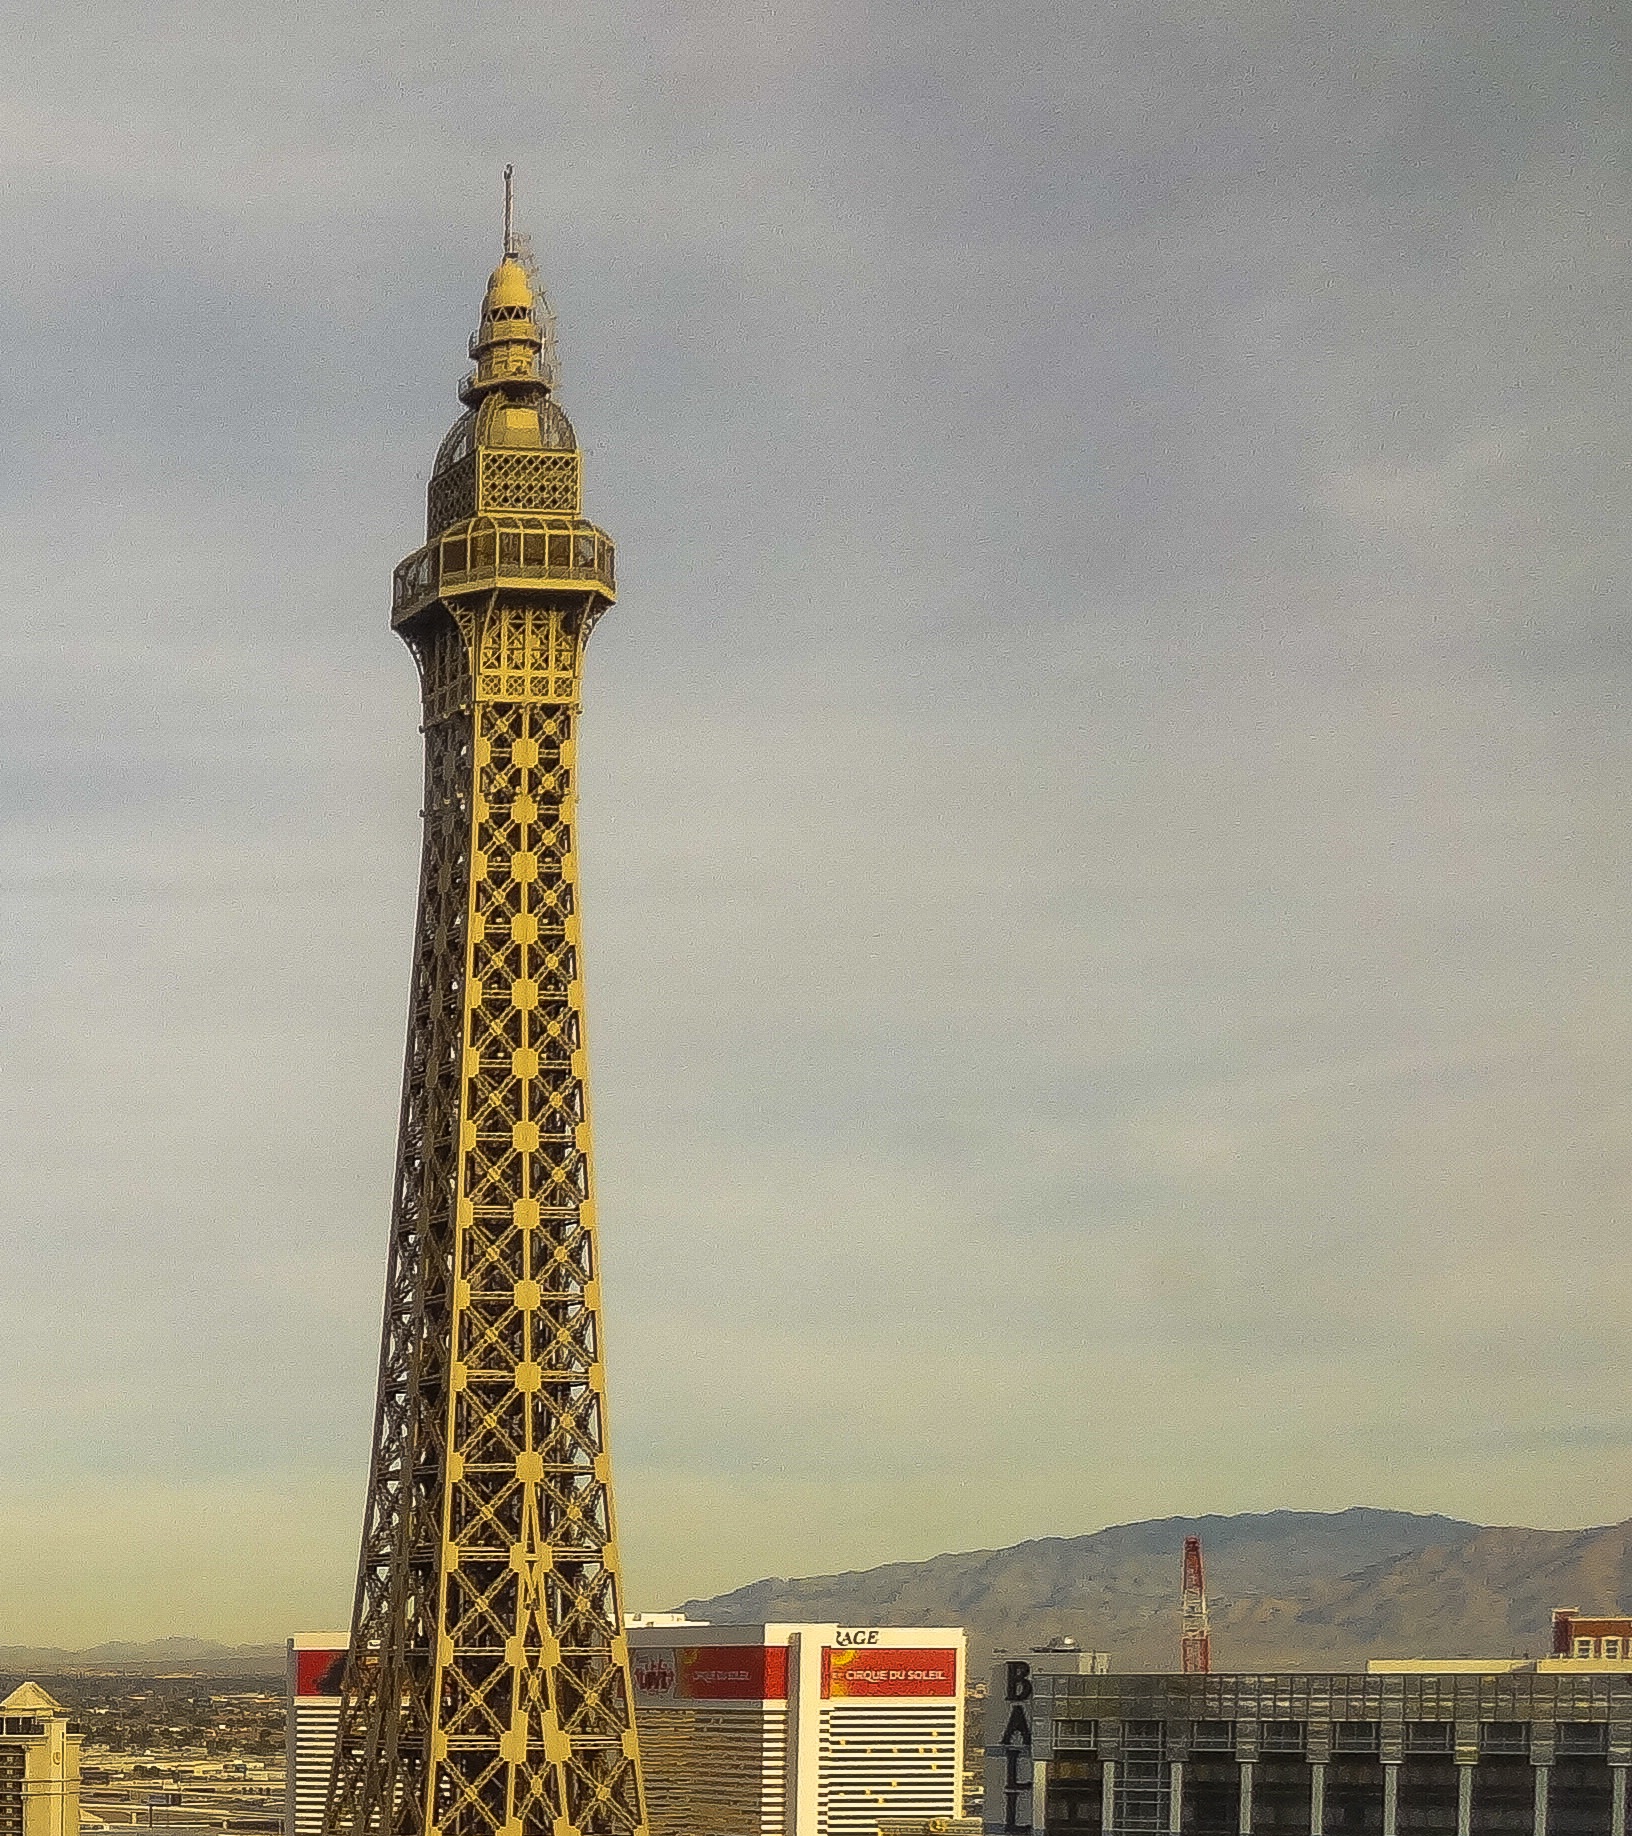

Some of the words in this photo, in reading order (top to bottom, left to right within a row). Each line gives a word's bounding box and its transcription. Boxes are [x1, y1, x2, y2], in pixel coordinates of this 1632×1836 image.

[845, 1670, 887, 1682] CIRQUE
[889, 1671, 905, 1680] DU
[907, 1671, 946, 1680] SOLEIL
